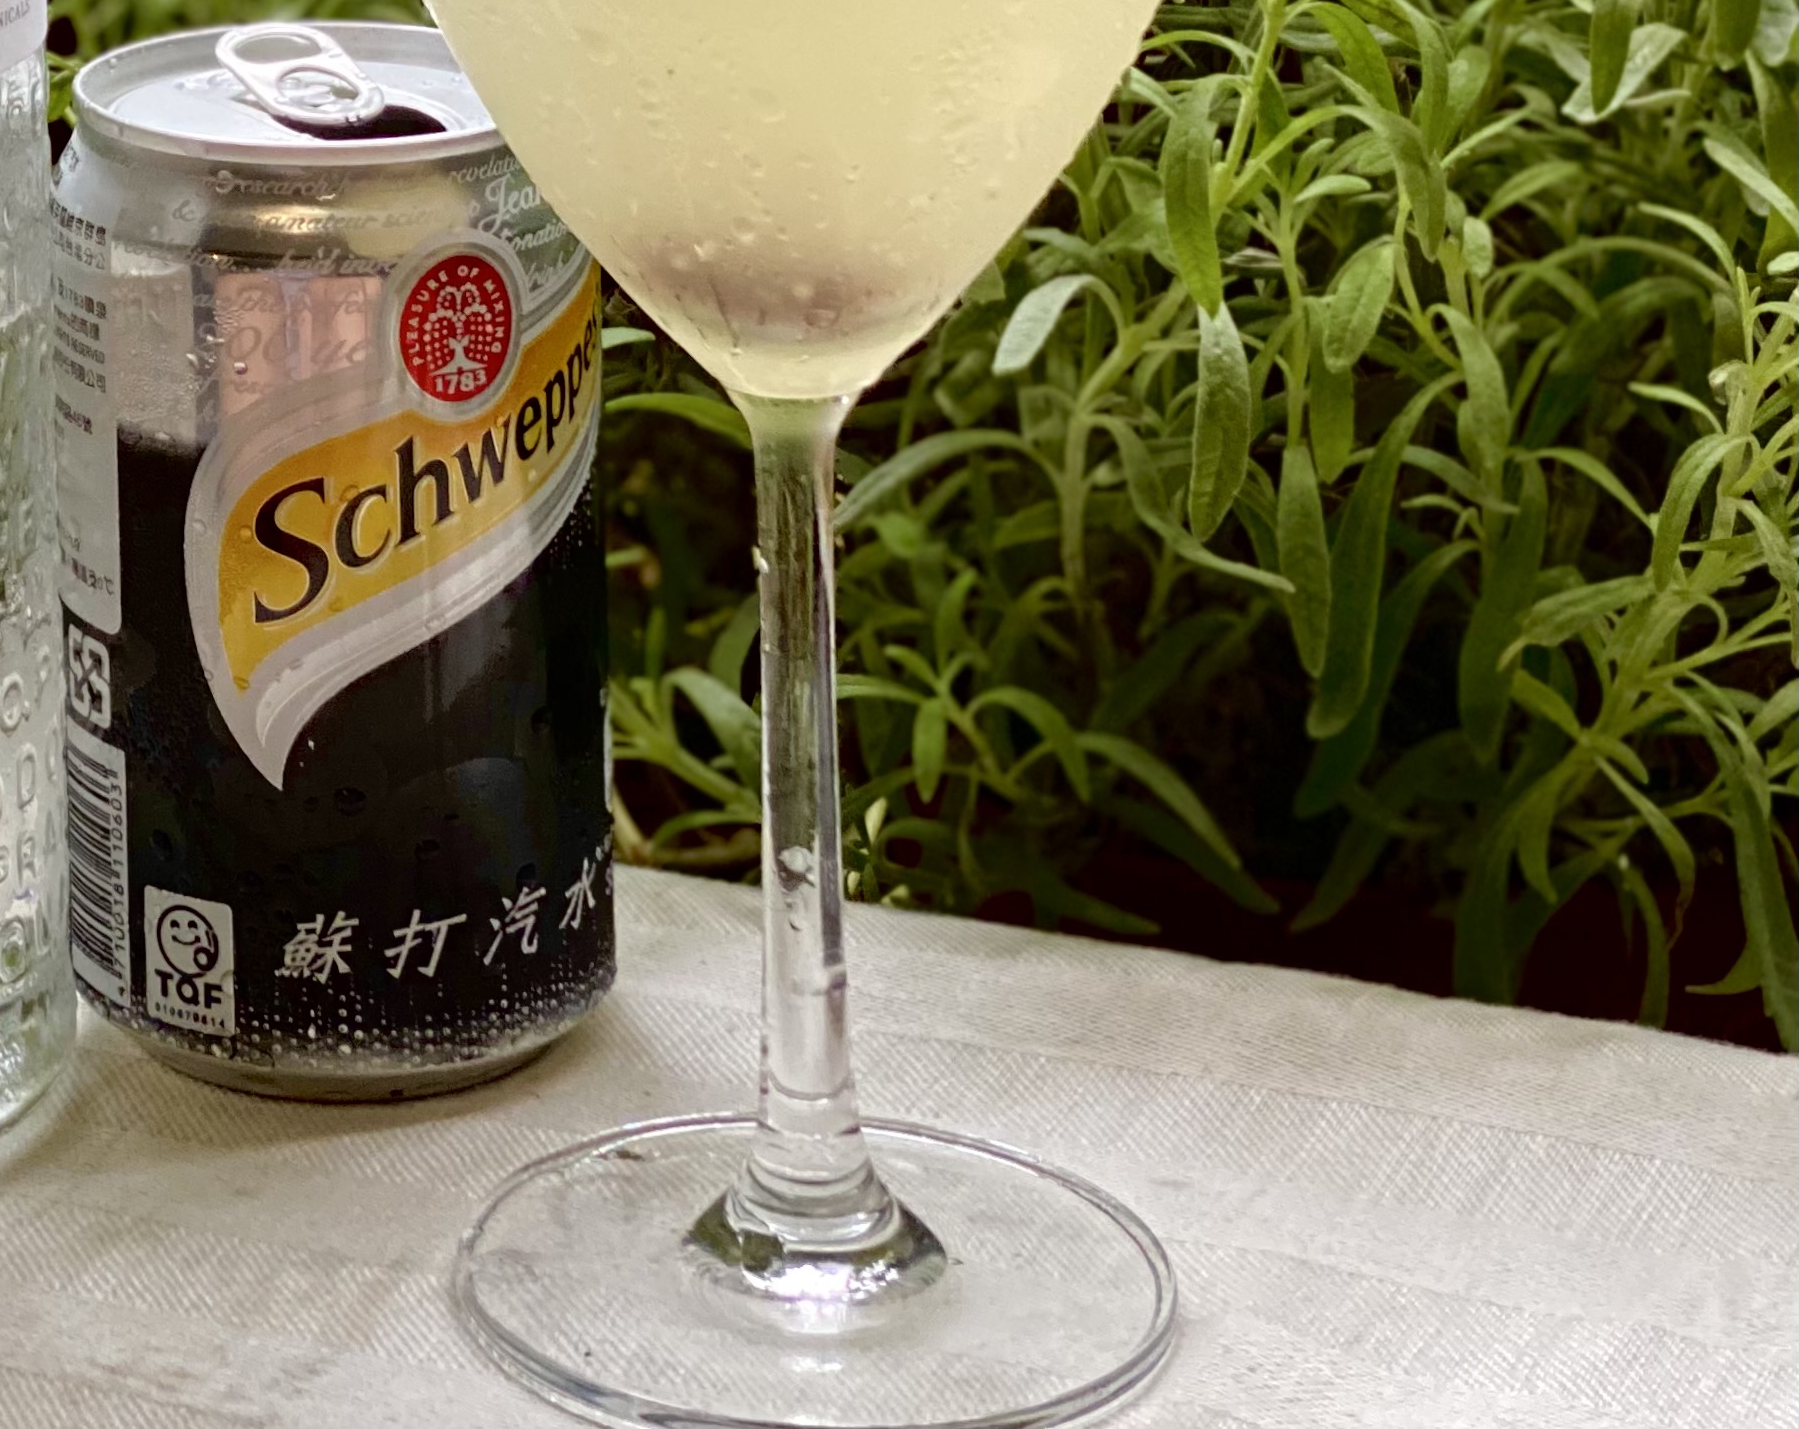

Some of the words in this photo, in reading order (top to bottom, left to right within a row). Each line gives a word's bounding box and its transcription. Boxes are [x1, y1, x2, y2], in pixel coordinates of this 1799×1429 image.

[406, 269, 450, 367] PLEASURE
[457, 265, 481, 278] OF
[483, 278, 506, 354] MIXING
[434, 369, 488, 395] 1783
[111, 782, 125, 869] 110603
[274, 856, 597, 985] 蘇打汽水
[154, 968, 224, 1009] TQF
